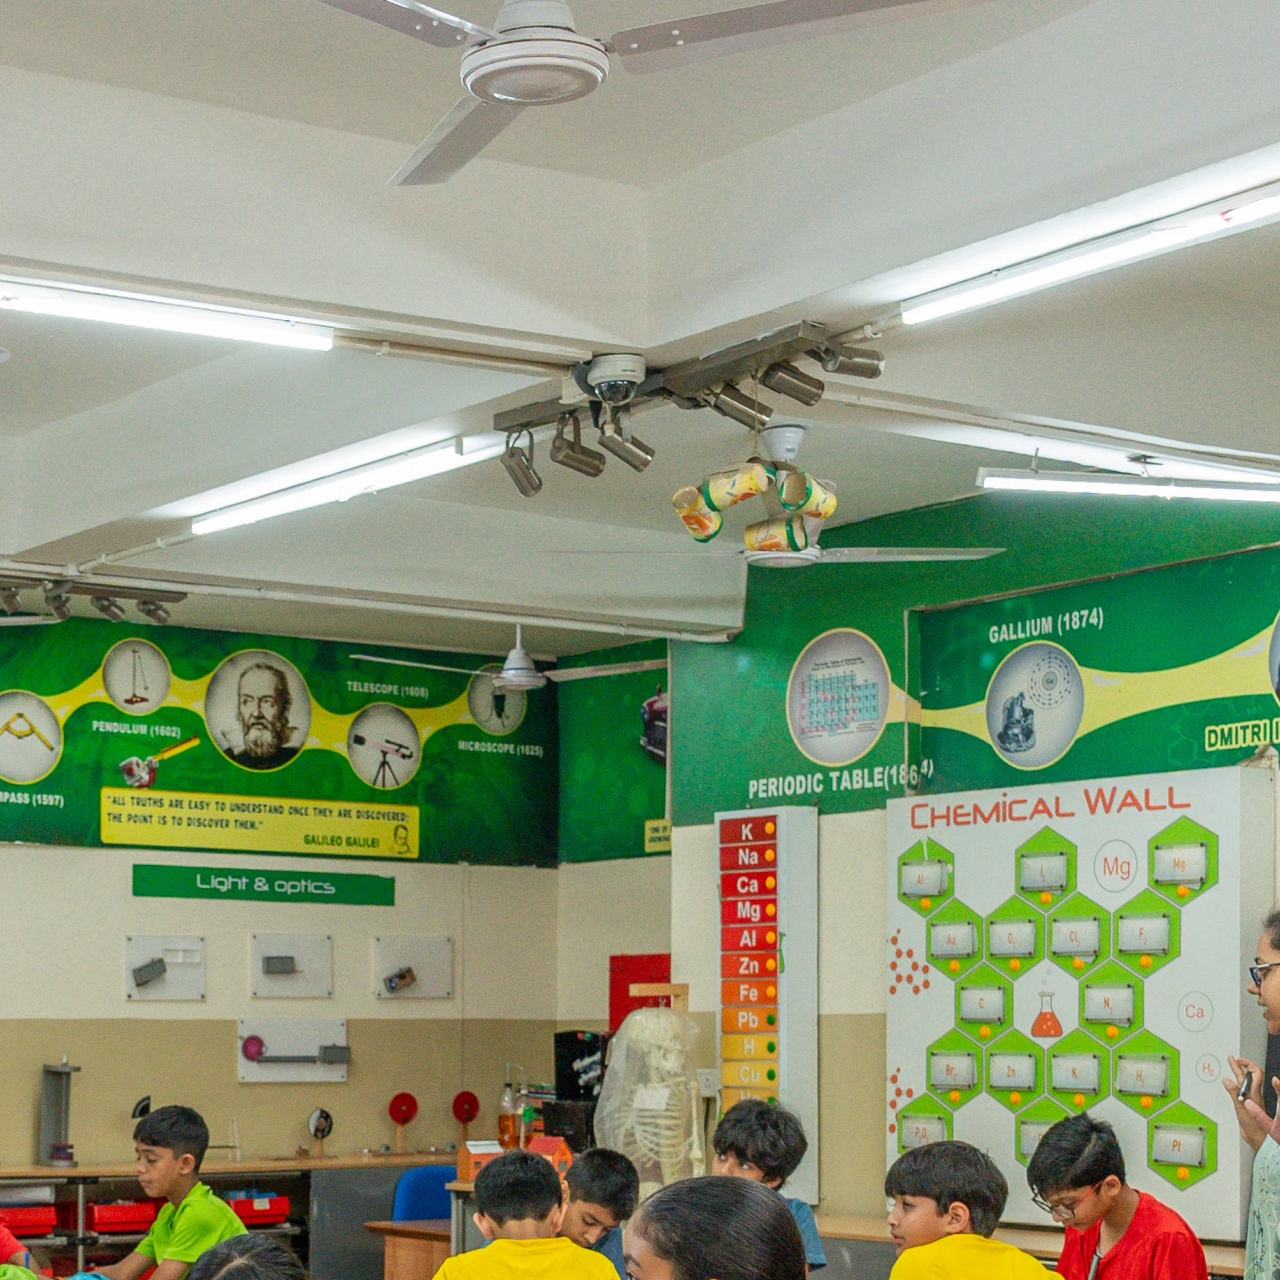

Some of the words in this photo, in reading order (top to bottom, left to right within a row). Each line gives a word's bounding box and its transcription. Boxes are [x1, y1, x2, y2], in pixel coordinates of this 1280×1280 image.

[989, 615, 1052, 644] GALLIUM
[1057, 607, 1104, 635] (1874)
[346, 680, 399, 696] TELESCOPE
[400, 685, 429, 699] (1608)
[92, 720, 148, 735] PENDULUM
[149, 725, 181, 739] (1602)
[1206, 723, 1270, 751] DMITRI
[457, 740, 515, 754] MICROSCOPE
[748, 771, 824, 799] PERIODIC
[32, 793, 65, 809] (1597)
[130, 796, 165, 809] TRUTHS
[168, 798, 184, 810] ARE
[187, 799, 211, 811] EASY
[214, 800, 227, 812] TO
[229, 802, 285, 815] UNDERSTAND
[287, 805, 309, 817] ONCE
[312, 806, 334, 818] THEY
[337, 808, 353, 819] ARE
[1083, 786, 1191, 815] WALL
[106, 812, 123, 824] THE
[126, 813, 154, 825] POINT
[171, 815, 184, 827] TO
[186, 816, 231, 829] DISCOVER
[303, 833, 343, 847] GALILEO
[345, 836, 380, 849] GALILEI
[740, 823, 753, 841] K
[737, 847, 759, 866] Na
[1173, 858, 1186, 872] Mg
[1103, 856, 1131, 880] Mg
[196, 873, 250, 893] Light
[253, 876, 269, 892] &
[274, 879, 336, 895] optics
[736, 875, 759, 894] Ca
[736, 901, 761, 923] Mg
[739, 929, 757, 948] Al
[945, 934, 956, 946] Au
[738, 956, 760, 975] Zn
[739, 983, 759, 1002] Fe
[978, 997, 985, 1009] C
[1185, 1004, 1205, 1019] Ca
[737, 1010, 759, 1030] Pb
[743, 1038, 755, 1057] H
[738, 1065, 761, 1083] Cu
[1006, 1066, 1016, 1078] Zn
[1072, 1066, 1078, 1079] K
[1202, 1062, 1215, 1077] H2
[1171, 1139, 1182, 1153] Pt
